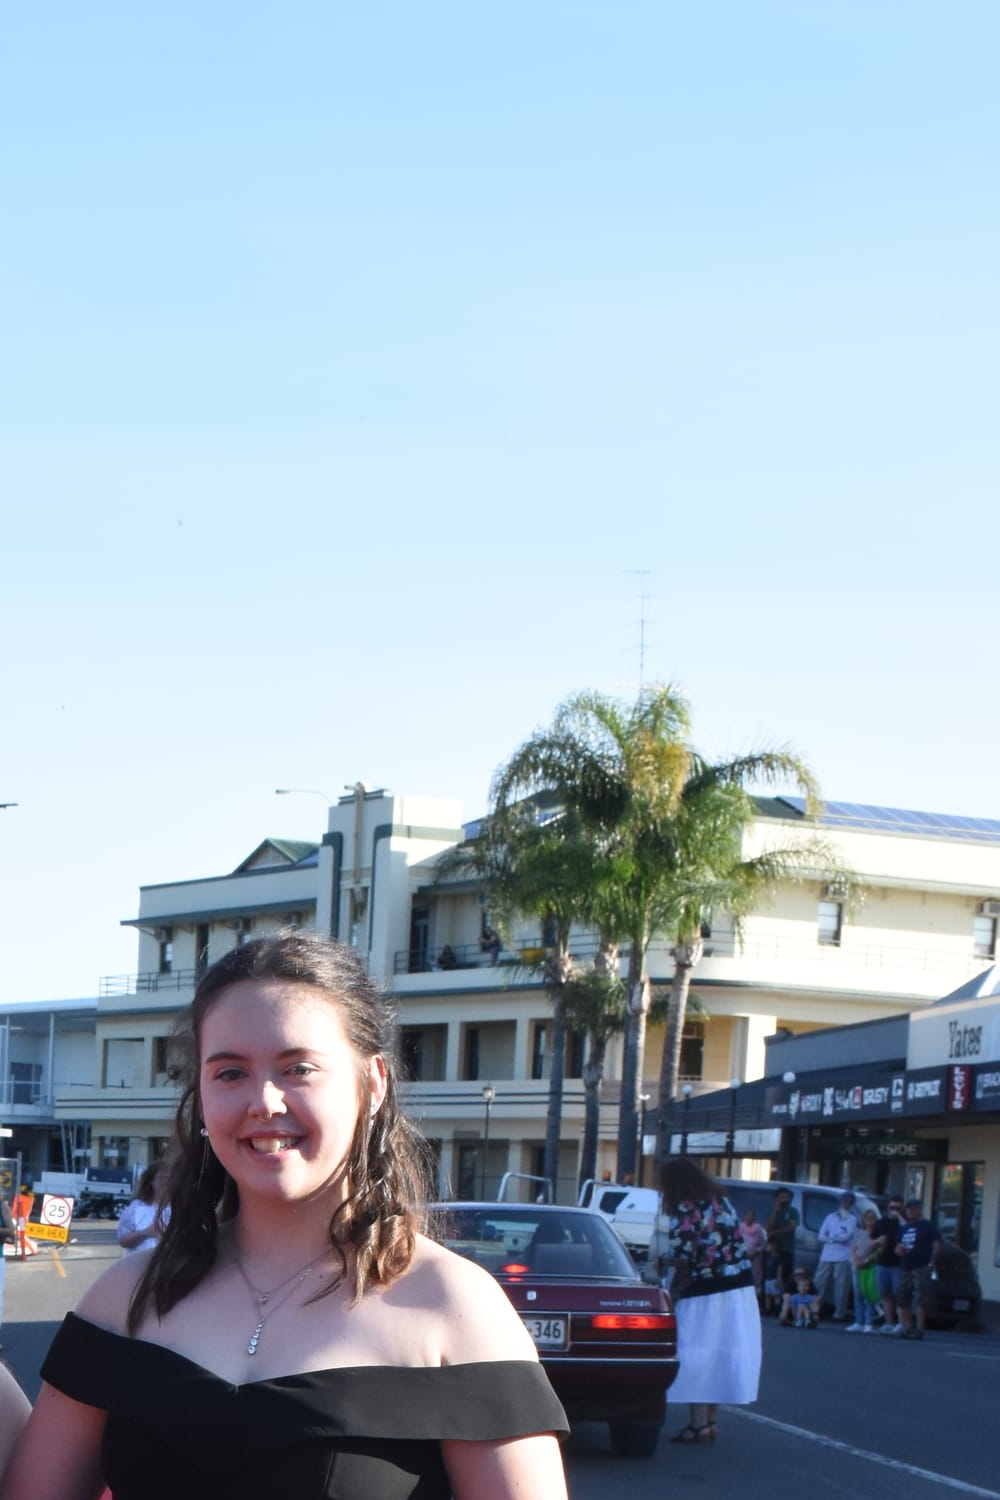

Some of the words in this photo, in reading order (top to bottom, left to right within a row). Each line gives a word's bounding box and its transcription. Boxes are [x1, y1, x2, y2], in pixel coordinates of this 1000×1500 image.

[948, 1020, 982, 1059] Yates
[49, 1204, 66, 1218] 25
[534, 1322, 561, 1339] 346
